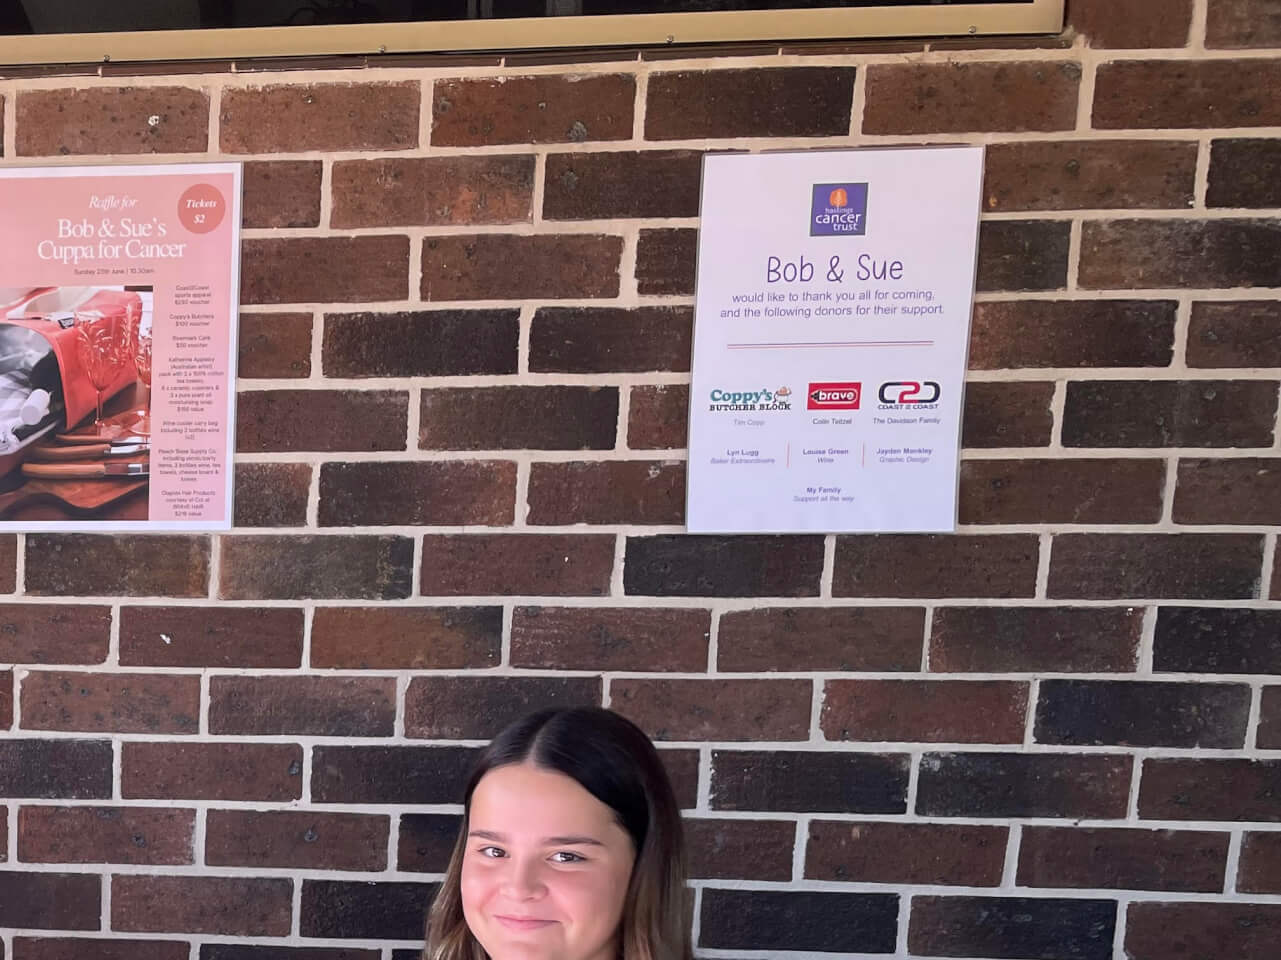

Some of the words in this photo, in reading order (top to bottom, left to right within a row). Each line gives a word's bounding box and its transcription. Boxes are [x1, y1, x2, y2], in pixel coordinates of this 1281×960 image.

[88, 194, 118, 211] Raffle
[120, 194, 138, 212] for
[186, 198, 217, 210] Tickets
[193, 213, 206, 224] $2
[815, 213, 862, 224] cancer
[58, 218, 95, 239] Bob
[98, 217, 116, 238] &
[120, 216, 167, 238] Sue's
[833, 223, 858, 231] trust
[38, 240, 96, 265] Cuppa
[98, 240, 122, 260] for
[124, 239, 187, 259] Cancer
[766, 256, 814, 283] Bob
[826, 256, 844, 284] &
[856, 254, 904, 281] Sue
[732, 292, 764, 304] would
[767, 292, 785, 302] like
[788, 292, 799, 302] to
[802, 292, 832, 302] thank
[835, 293, 856, 304] you
[858, 290, 871, 300] all
[874, 290, 890, 300] for
[720, 308, 740, 318] and
[744, 308, 761, 318] the
[764, 306, 811, 320] following
[814, 306, 852, 316] donors
[856, 306, 870, 316] for
[873, 305, 898, 316] their
[710, 388, 773, 404] Coppy's
[818, 390, 855, 402] brave
[710, 404, 756, 412] BUTCHER
[759, 402, 792, 411] BLOCK
